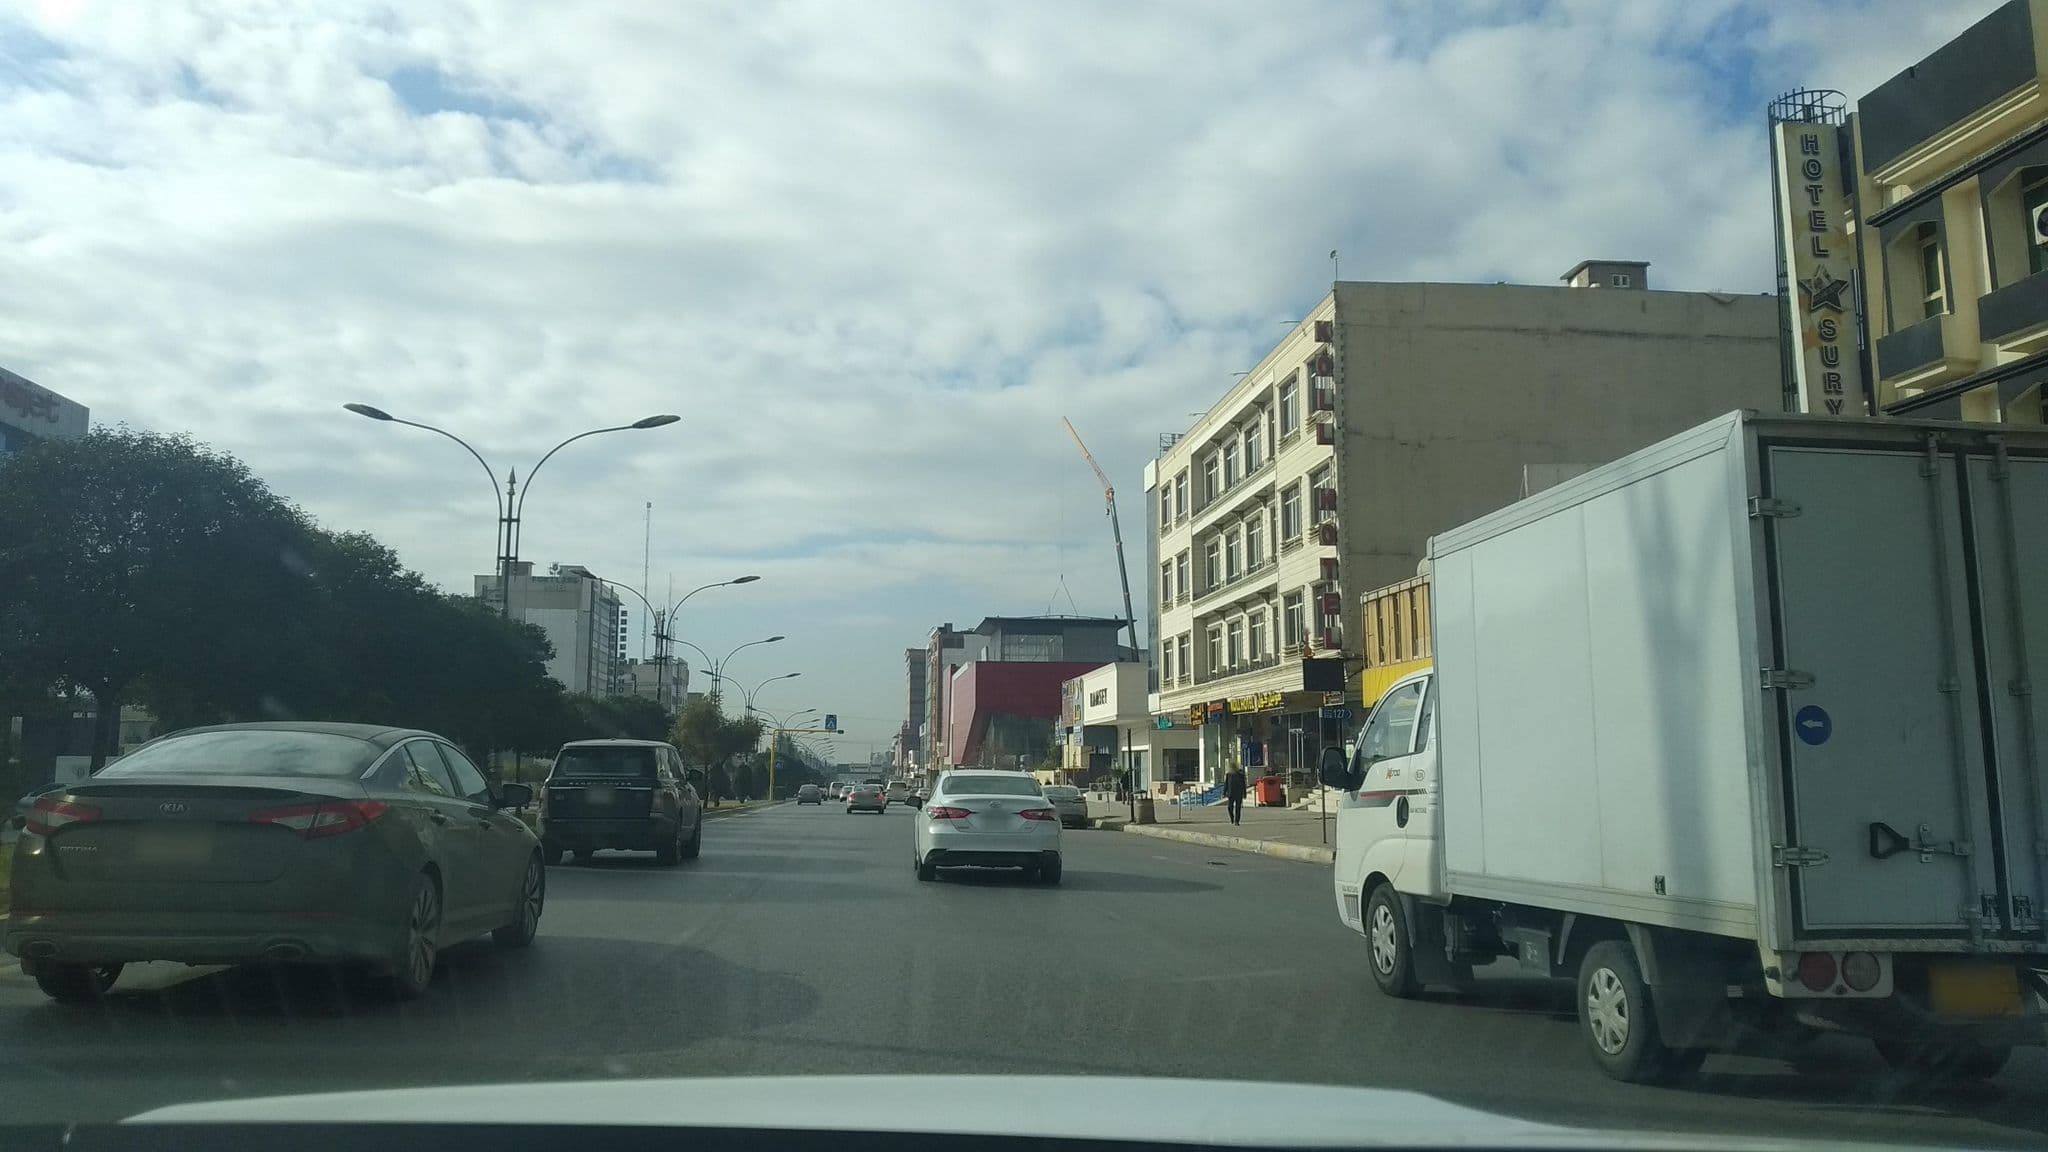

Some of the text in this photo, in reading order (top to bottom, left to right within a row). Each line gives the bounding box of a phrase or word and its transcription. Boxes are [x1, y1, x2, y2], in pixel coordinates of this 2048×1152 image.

[1801, 133, 1845, 416] HOTEL SURY
[161, 801, 187, 814] KIA
